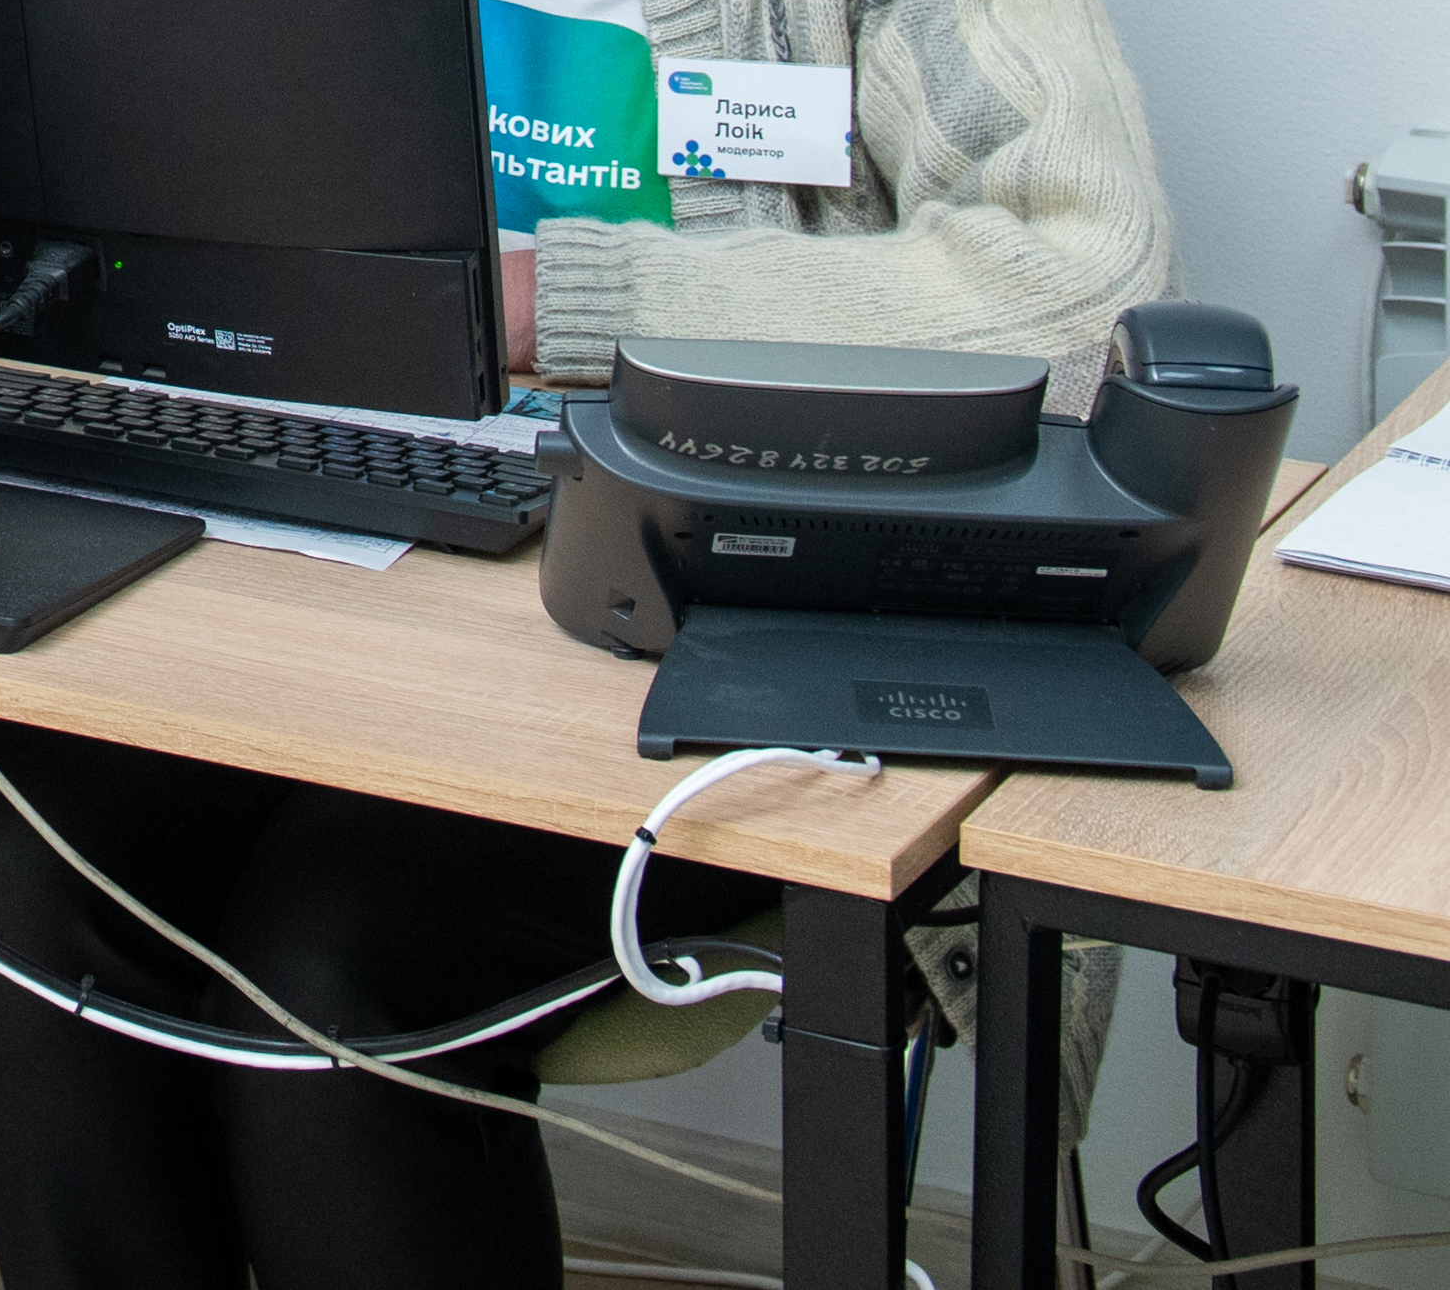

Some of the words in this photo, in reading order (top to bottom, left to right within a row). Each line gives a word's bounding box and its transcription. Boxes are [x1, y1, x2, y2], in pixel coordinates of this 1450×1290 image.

[715, 99, 797, 120] Лариса
[715, 122, 764, 140] Лоік
[717, 145, 785, 160] модератор
[889, 706, 961, 720] CISCO
